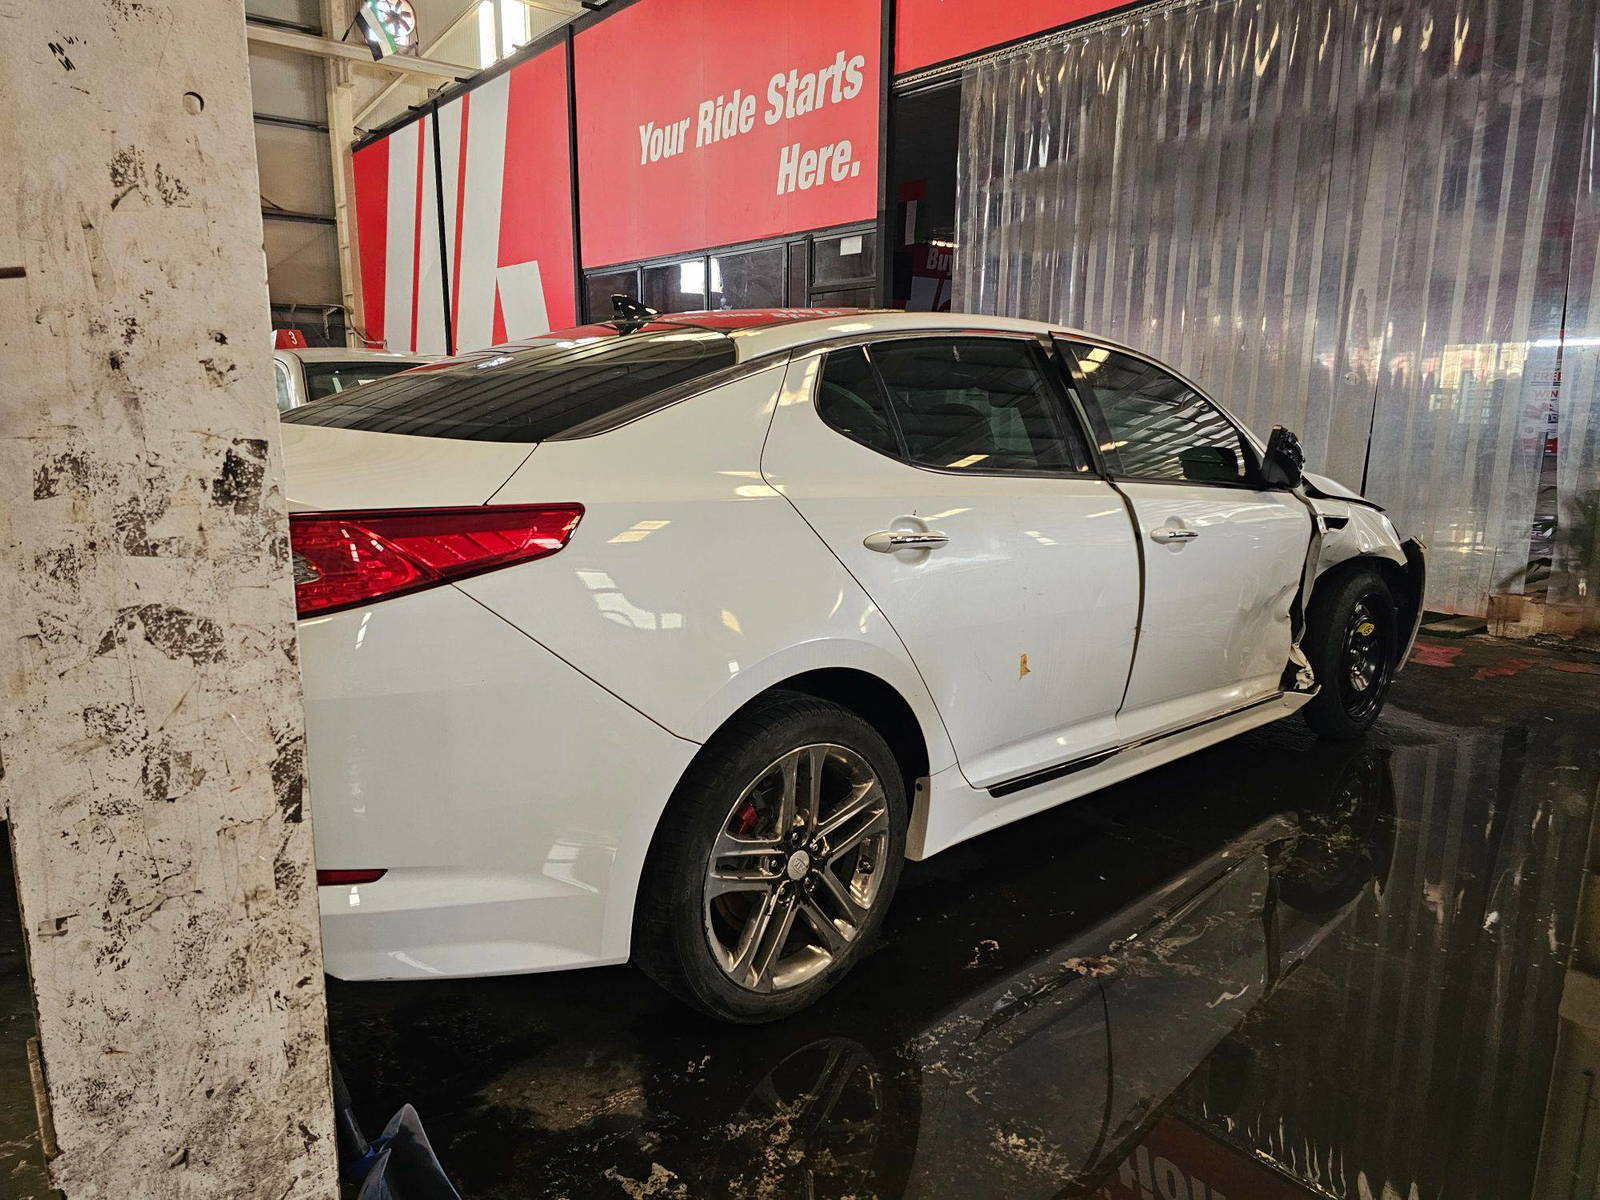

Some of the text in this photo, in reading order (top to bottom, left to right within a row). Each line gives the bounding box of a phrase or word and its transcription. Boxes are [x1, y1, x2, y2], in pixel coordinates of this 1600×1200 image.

[639, 50, 864, 165] Your Ride Starts
[777, 140, 860, 195] Here.
[289, 331, 298, 345] 3
